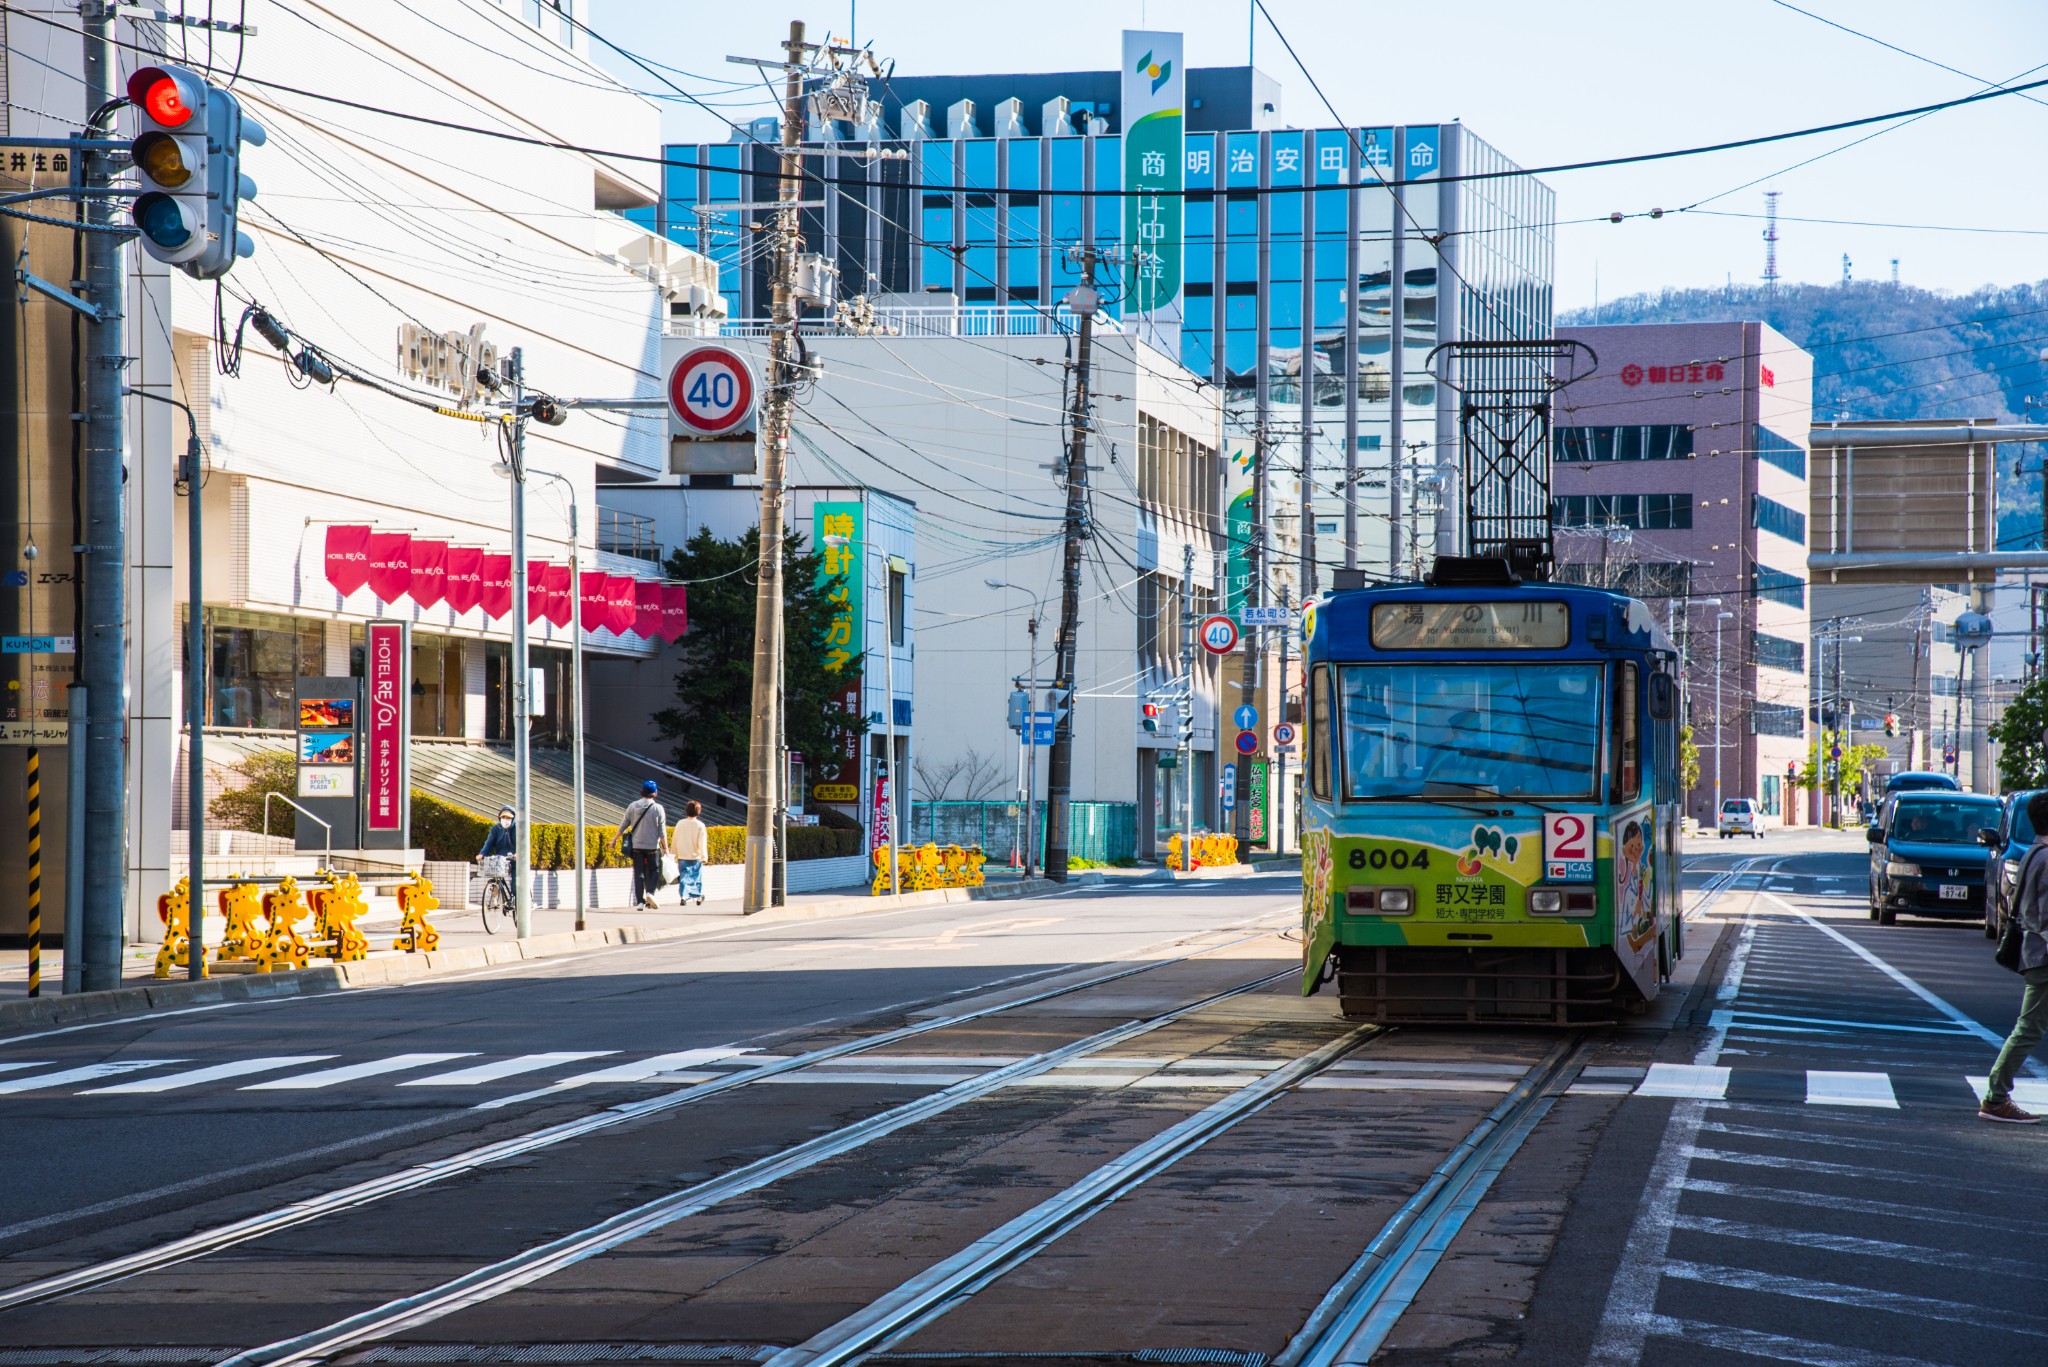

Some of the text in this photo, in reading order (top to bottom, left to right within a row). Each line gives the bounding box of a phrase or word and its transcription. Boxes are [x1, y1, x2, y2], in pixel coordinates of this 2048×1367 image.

[1187, 142, 1434, 174] 明治安田生命
[1141, 151, 1166, 279] 商工中金
[1648, 364, 1725, 384] 朝日生命
[687, 372, 734, 408] 40
[346, 551, 367, 562] RESOL
[387, 560, 408, 570] RESOL
[425, 567, 445, 576] RESOL
[461, 573, 481, 582] RESOL
[495, 579, 512, 588] RESO
[528, 585, 547, 594] RESOL
[588, 594, 606, 603] RESOL
[616, 599, 633, 607] RESOL
[643, 604, 660, 612] RESOL
[1244, 608, 1287, 619] 若松町3
[1208, 627, 1230, 644] 40
[1443, 626, 1487, 634] Yunokawa
[6, 640, 51, 650] KUMON
[374, 637, 397, 731] HOTEL RESOL
[379, 739, 390, 817] ホテルリソル函館
[1553, 815, 1586, 859] 2
[1348, 848, 1430, 870] 8004
[1567, 862, 1592, 872] ICAS
[1436, 884, 1505, 905] 野又学園
[1436, 908, 1505, 920] 短大・専門学校号
